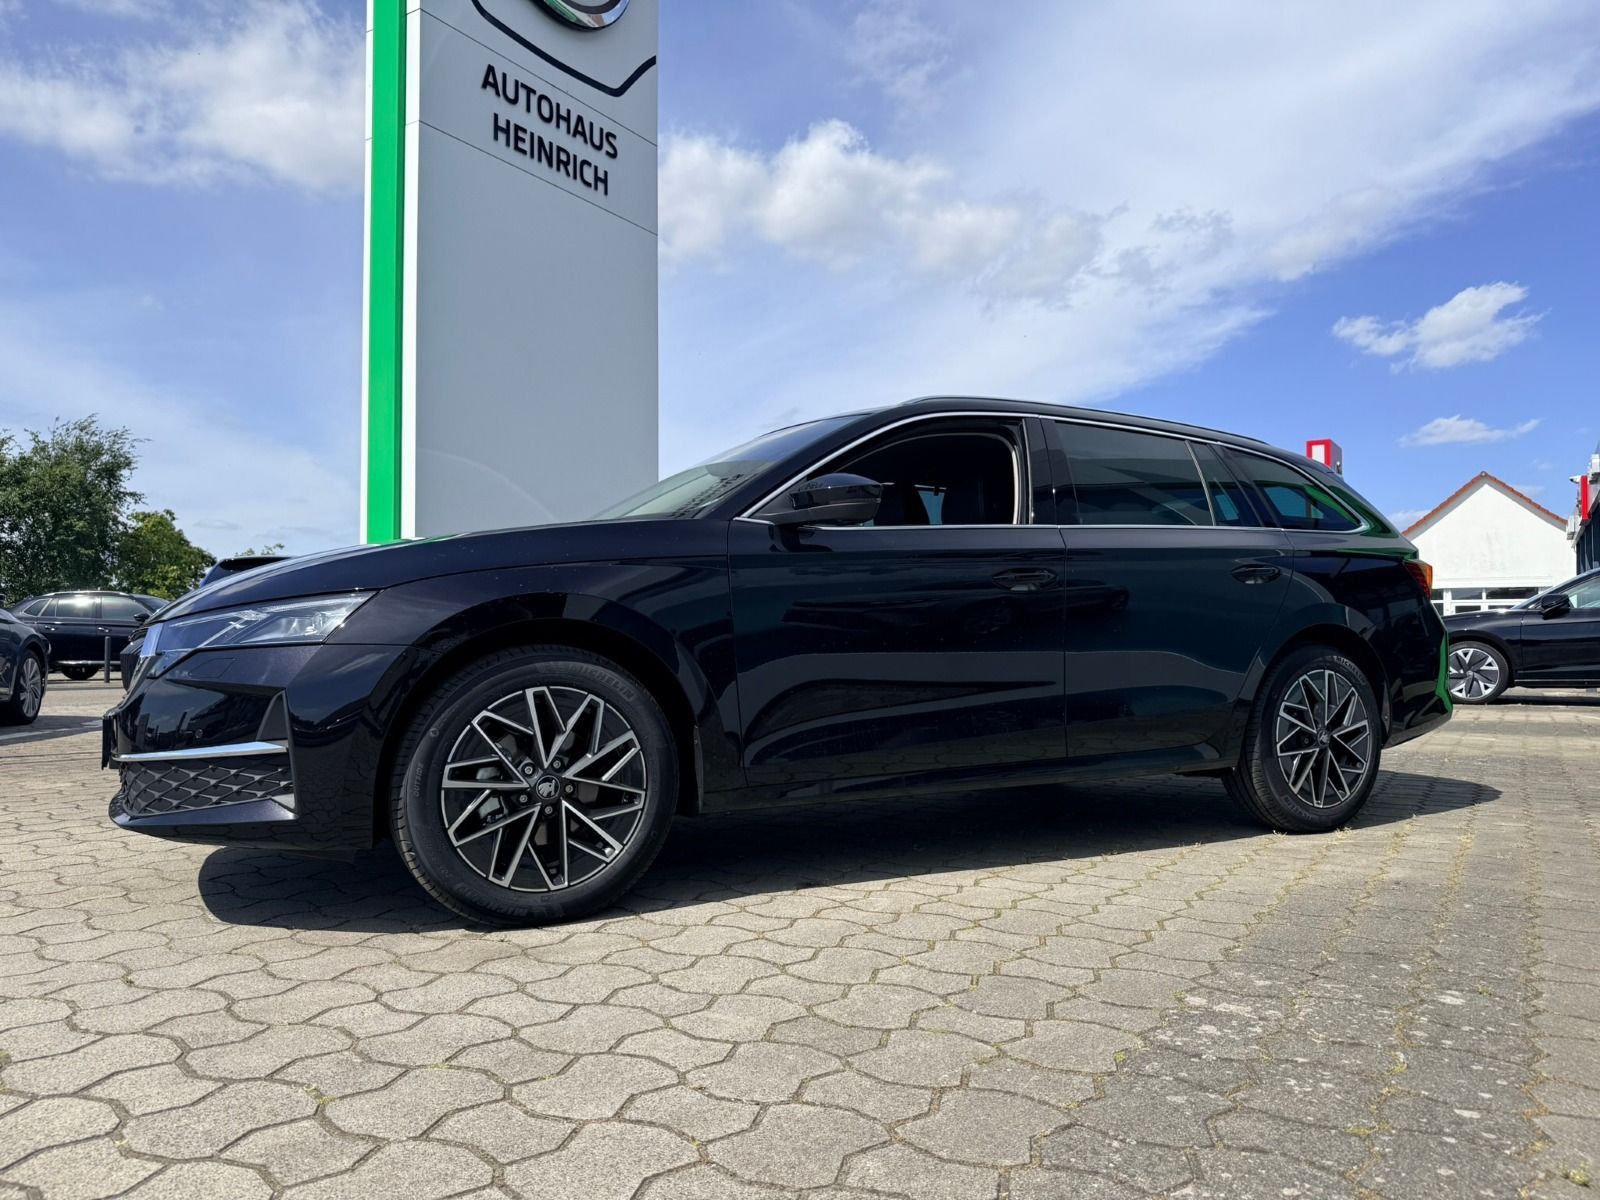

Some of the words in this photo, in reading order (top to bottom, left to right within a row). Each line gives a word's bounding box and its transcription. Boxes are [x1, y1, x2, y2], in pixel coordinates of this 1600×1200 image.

[482, 64, 618, 159] AUTOHAUS
[493, 113, 609, 196] HEINRICH
[568, 664, 635, 700] MICHELIN
